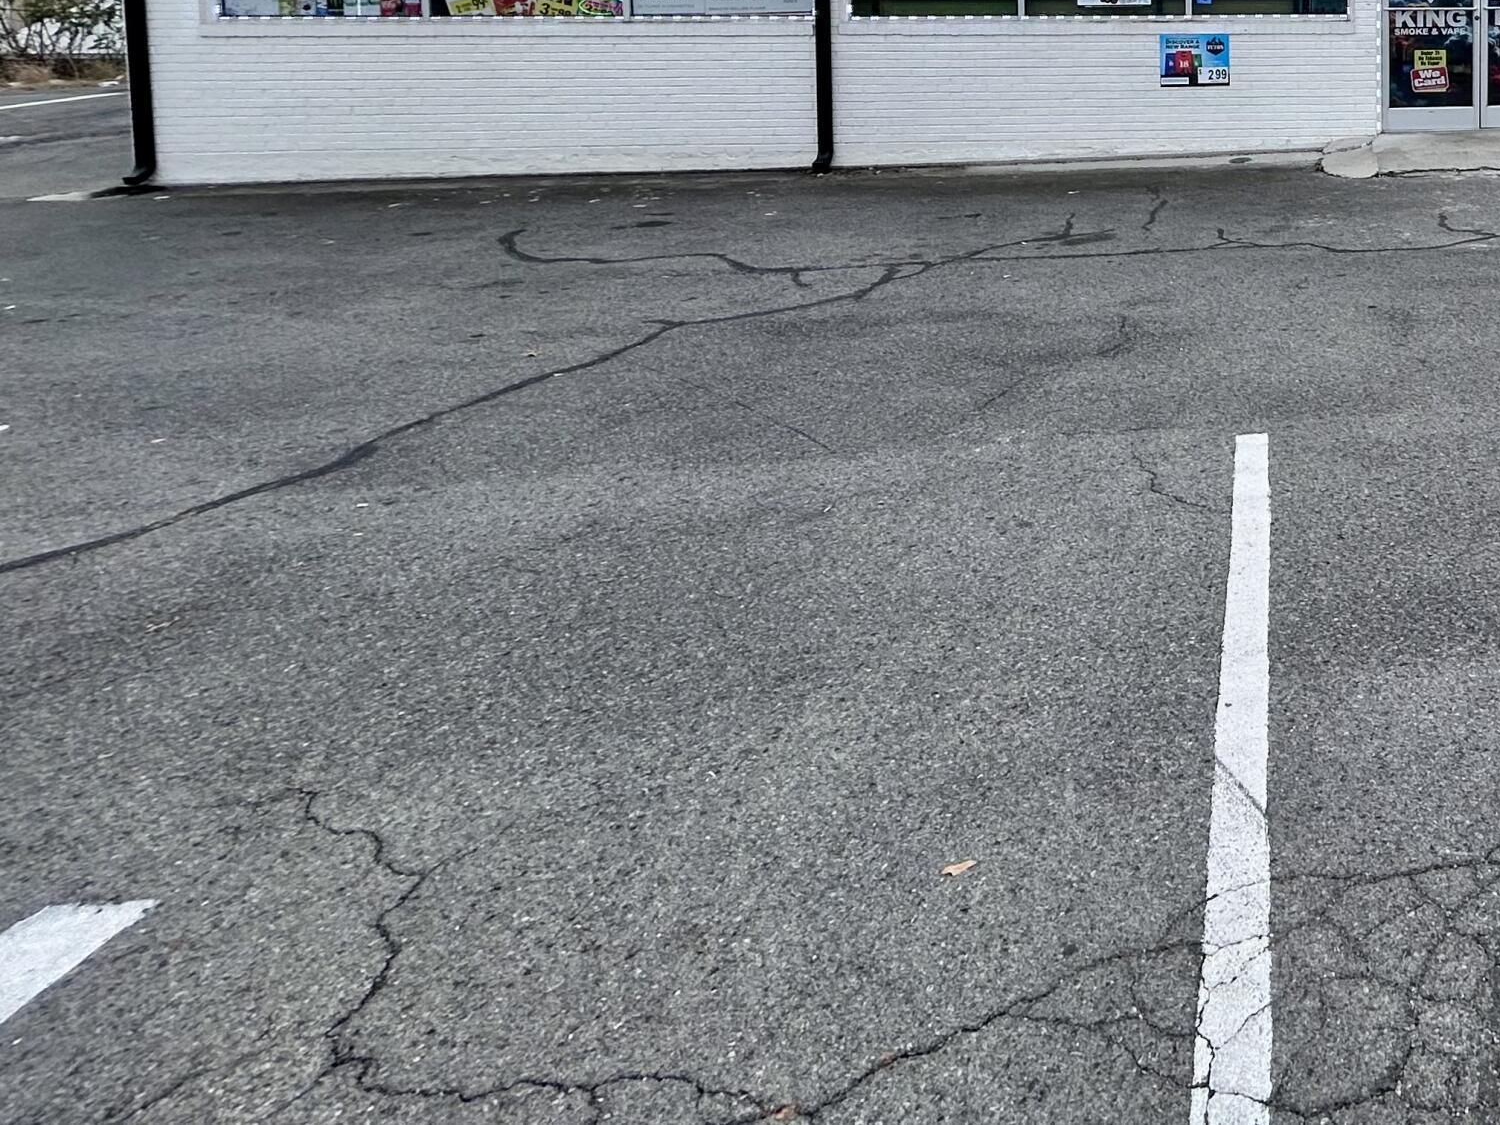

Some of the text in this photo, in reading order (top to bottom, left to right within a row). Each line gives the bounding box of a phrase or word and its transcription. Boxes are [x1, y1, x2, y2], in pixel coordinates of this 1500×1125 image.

[1395, 10, 1467, 28] KING
[1394, 27, 1466, 35] SMOKE & VAPE
[1208, 68, 1227, 80] 299
[1418, 69, 1440, 78] We
[1414, 76, 1446, 87] Card
